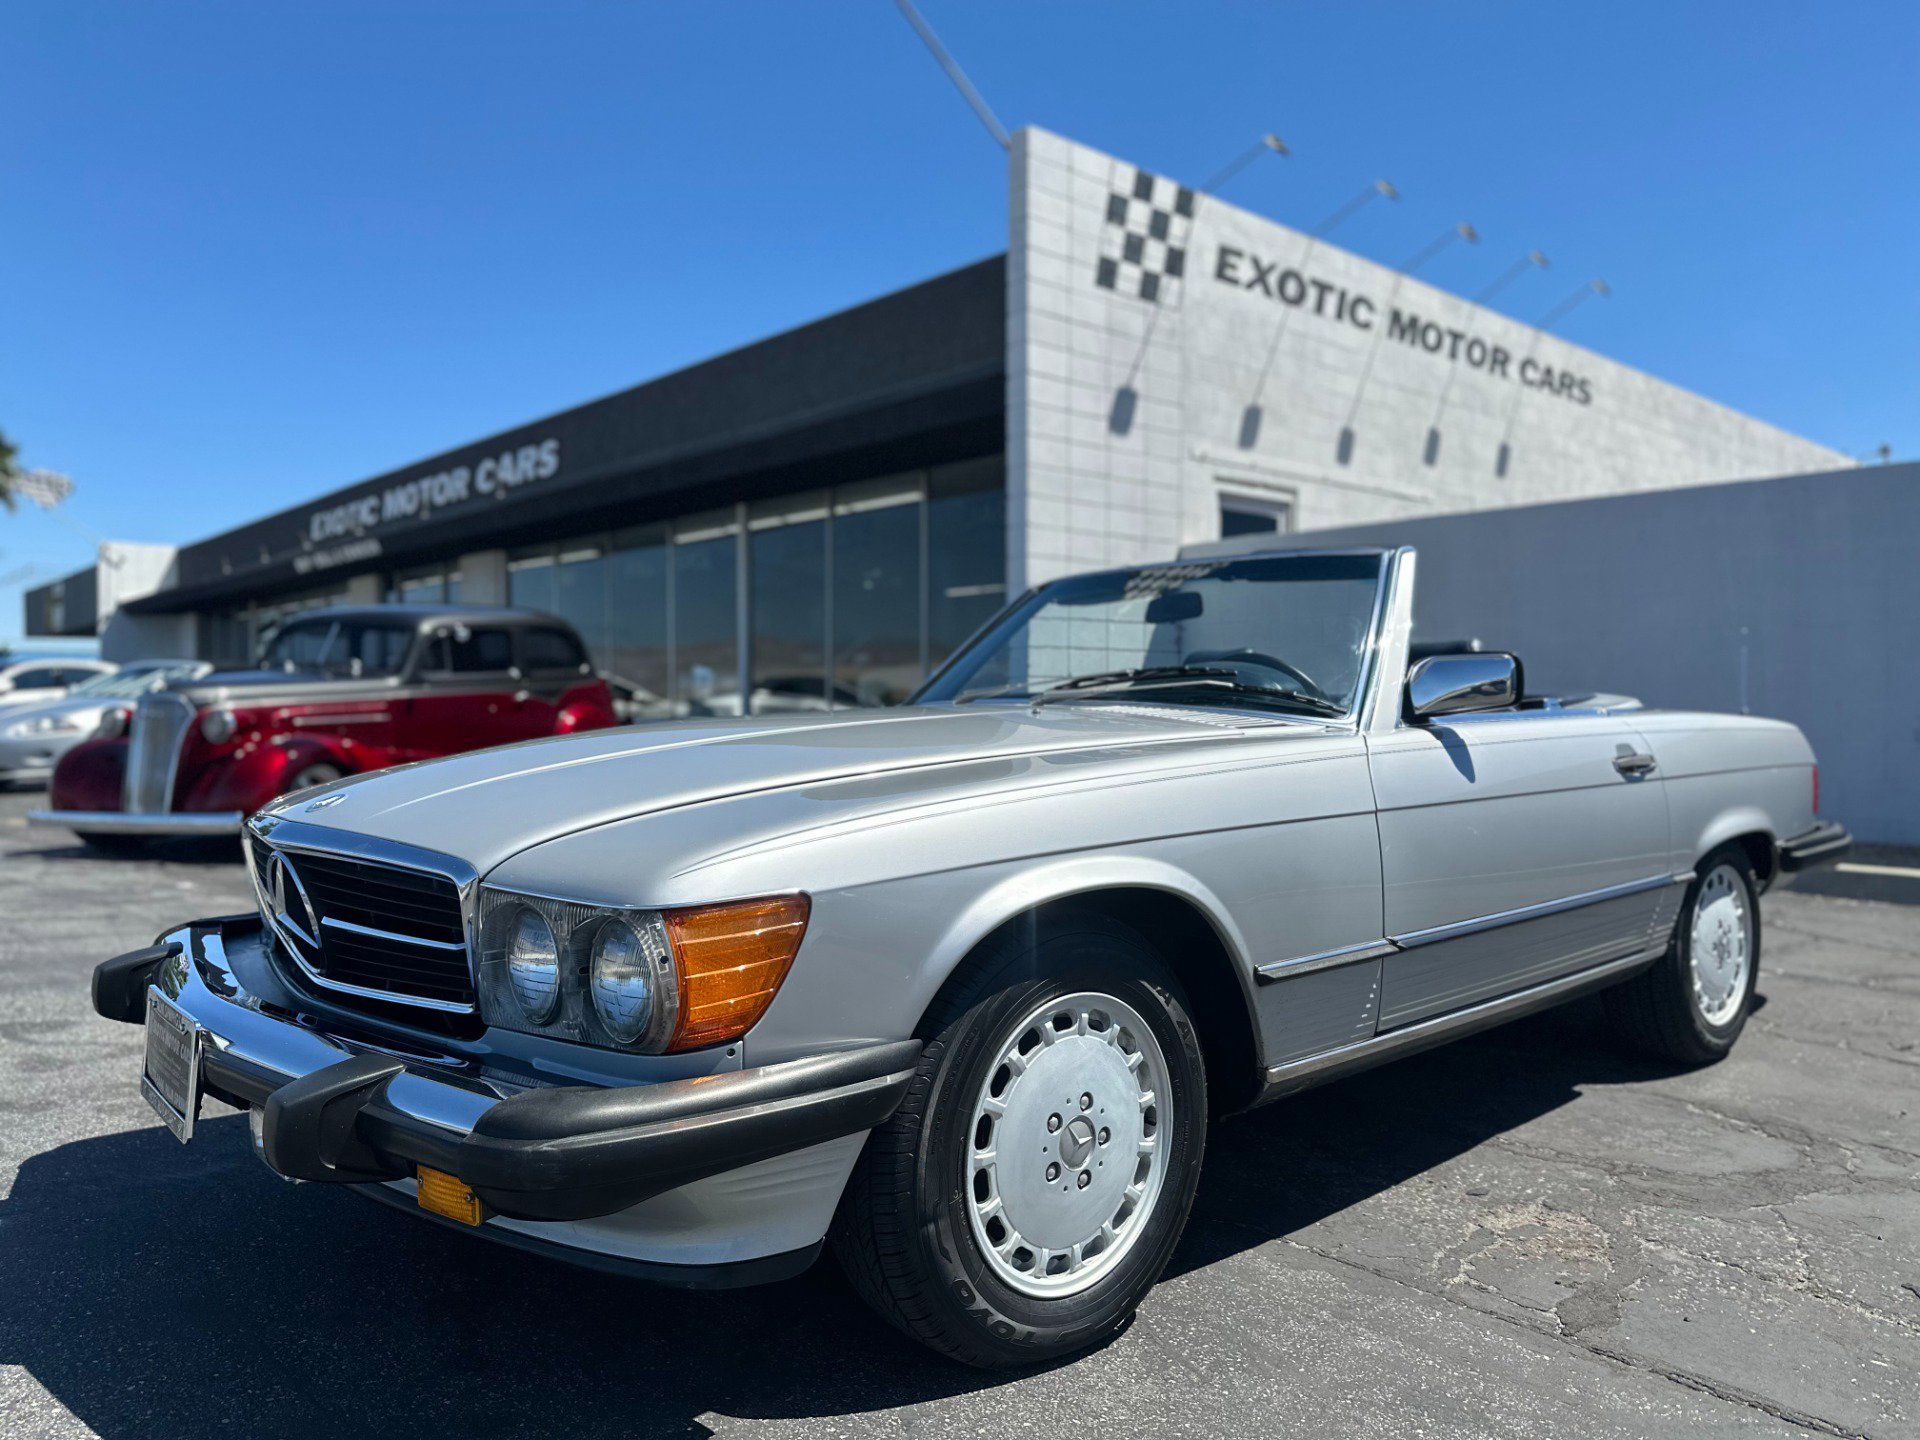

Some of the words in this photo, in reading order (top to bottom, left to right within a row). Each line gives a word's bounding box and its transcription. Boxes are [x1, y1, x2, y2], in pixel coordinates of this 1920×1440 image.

[1213, 244, 1376, 331] EXOTIC
[1386, 306, 1512, 380] MOTOR
[1518, 358, 1593, 406] CARS
[309, 494, 380, 542] EXOTIC
[380, 465, 471, 522] MOTOR
[474, 437, 560, 494] CARS
[952, 1278, 1039, 1348] TOYO
